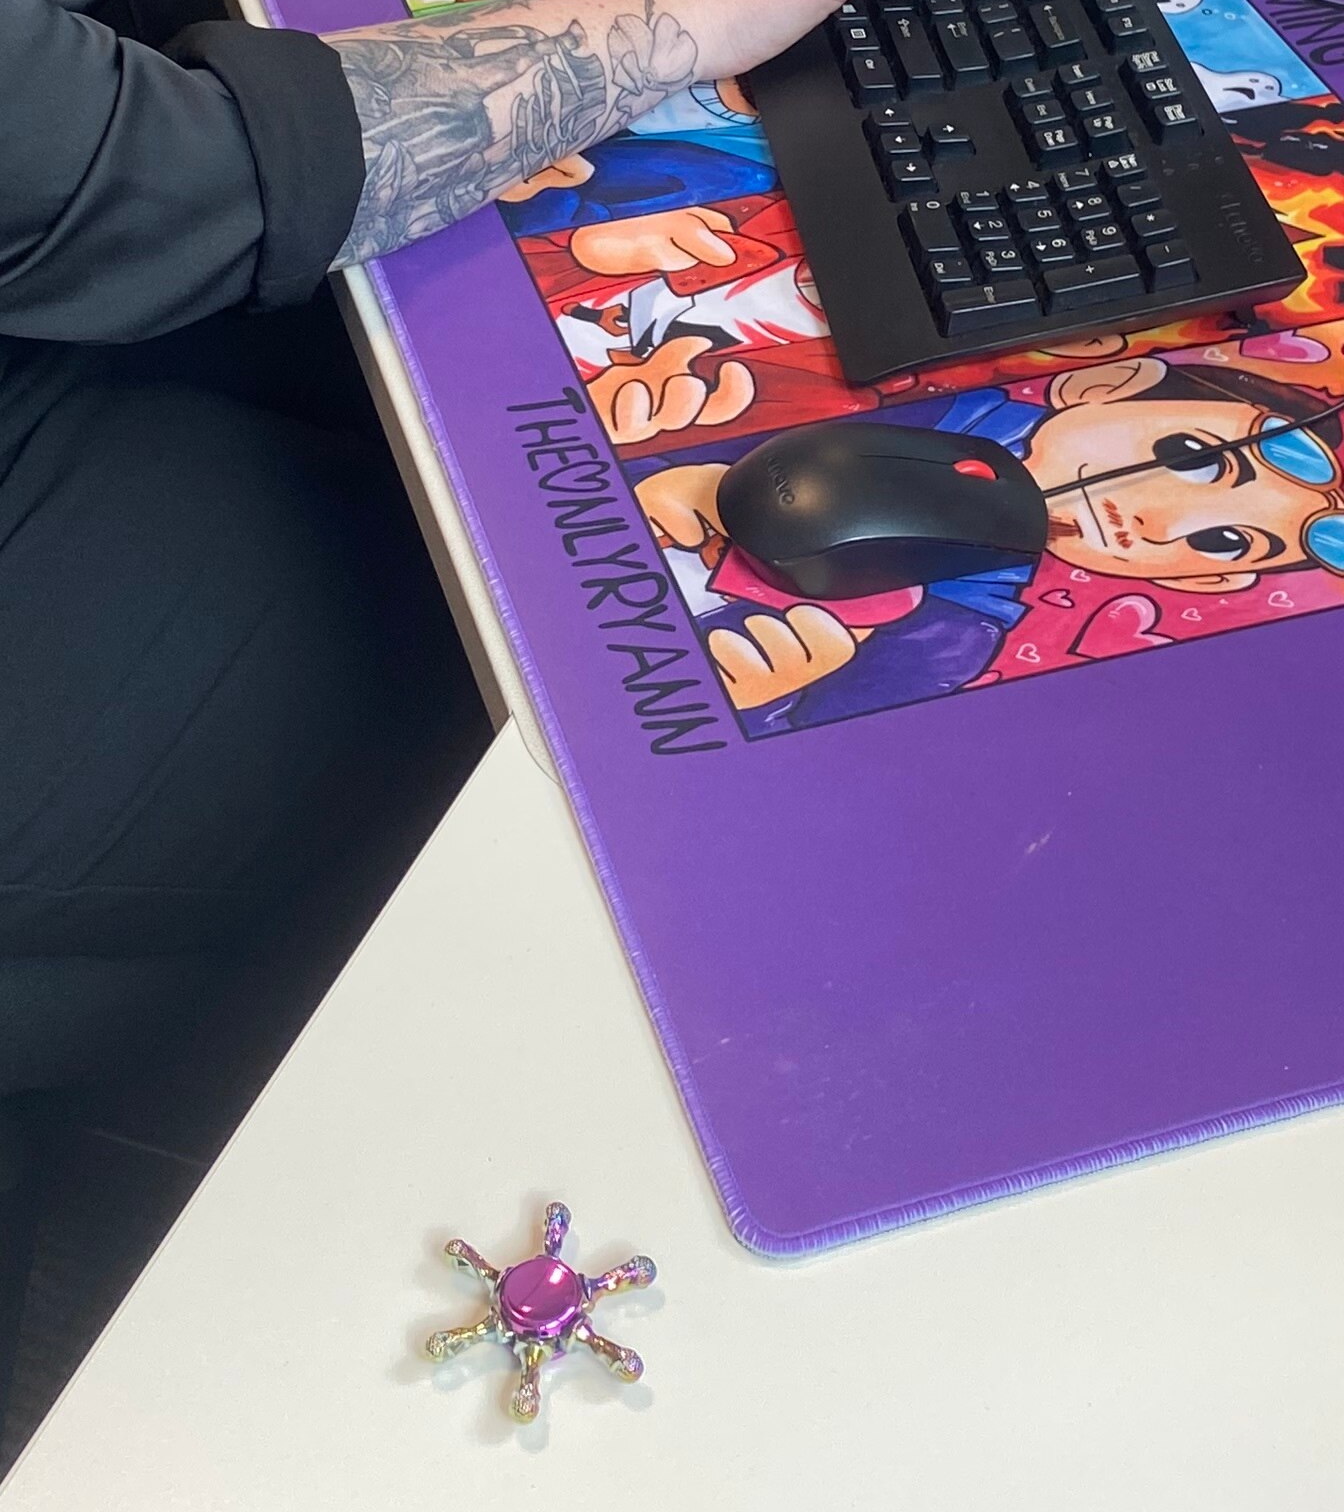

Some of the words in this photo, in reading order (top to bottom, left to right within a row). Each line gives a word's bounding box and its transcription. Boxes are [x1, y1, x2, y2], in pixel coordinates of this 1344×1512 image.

[1074, 168, 1090, 177] 7
[1026, 180, 1041, 190] 4
[925, 200, 941, 210] 0
[1087, 196, 1103, 206] 8
[1037, 209, 1052, 219] 5
[987, 219, 1004, 229] 2
[1102, 226, 1117, 236] 9
[1051, 239, 1067, 248] 6
[1001, 250, 1016, 259] 3
